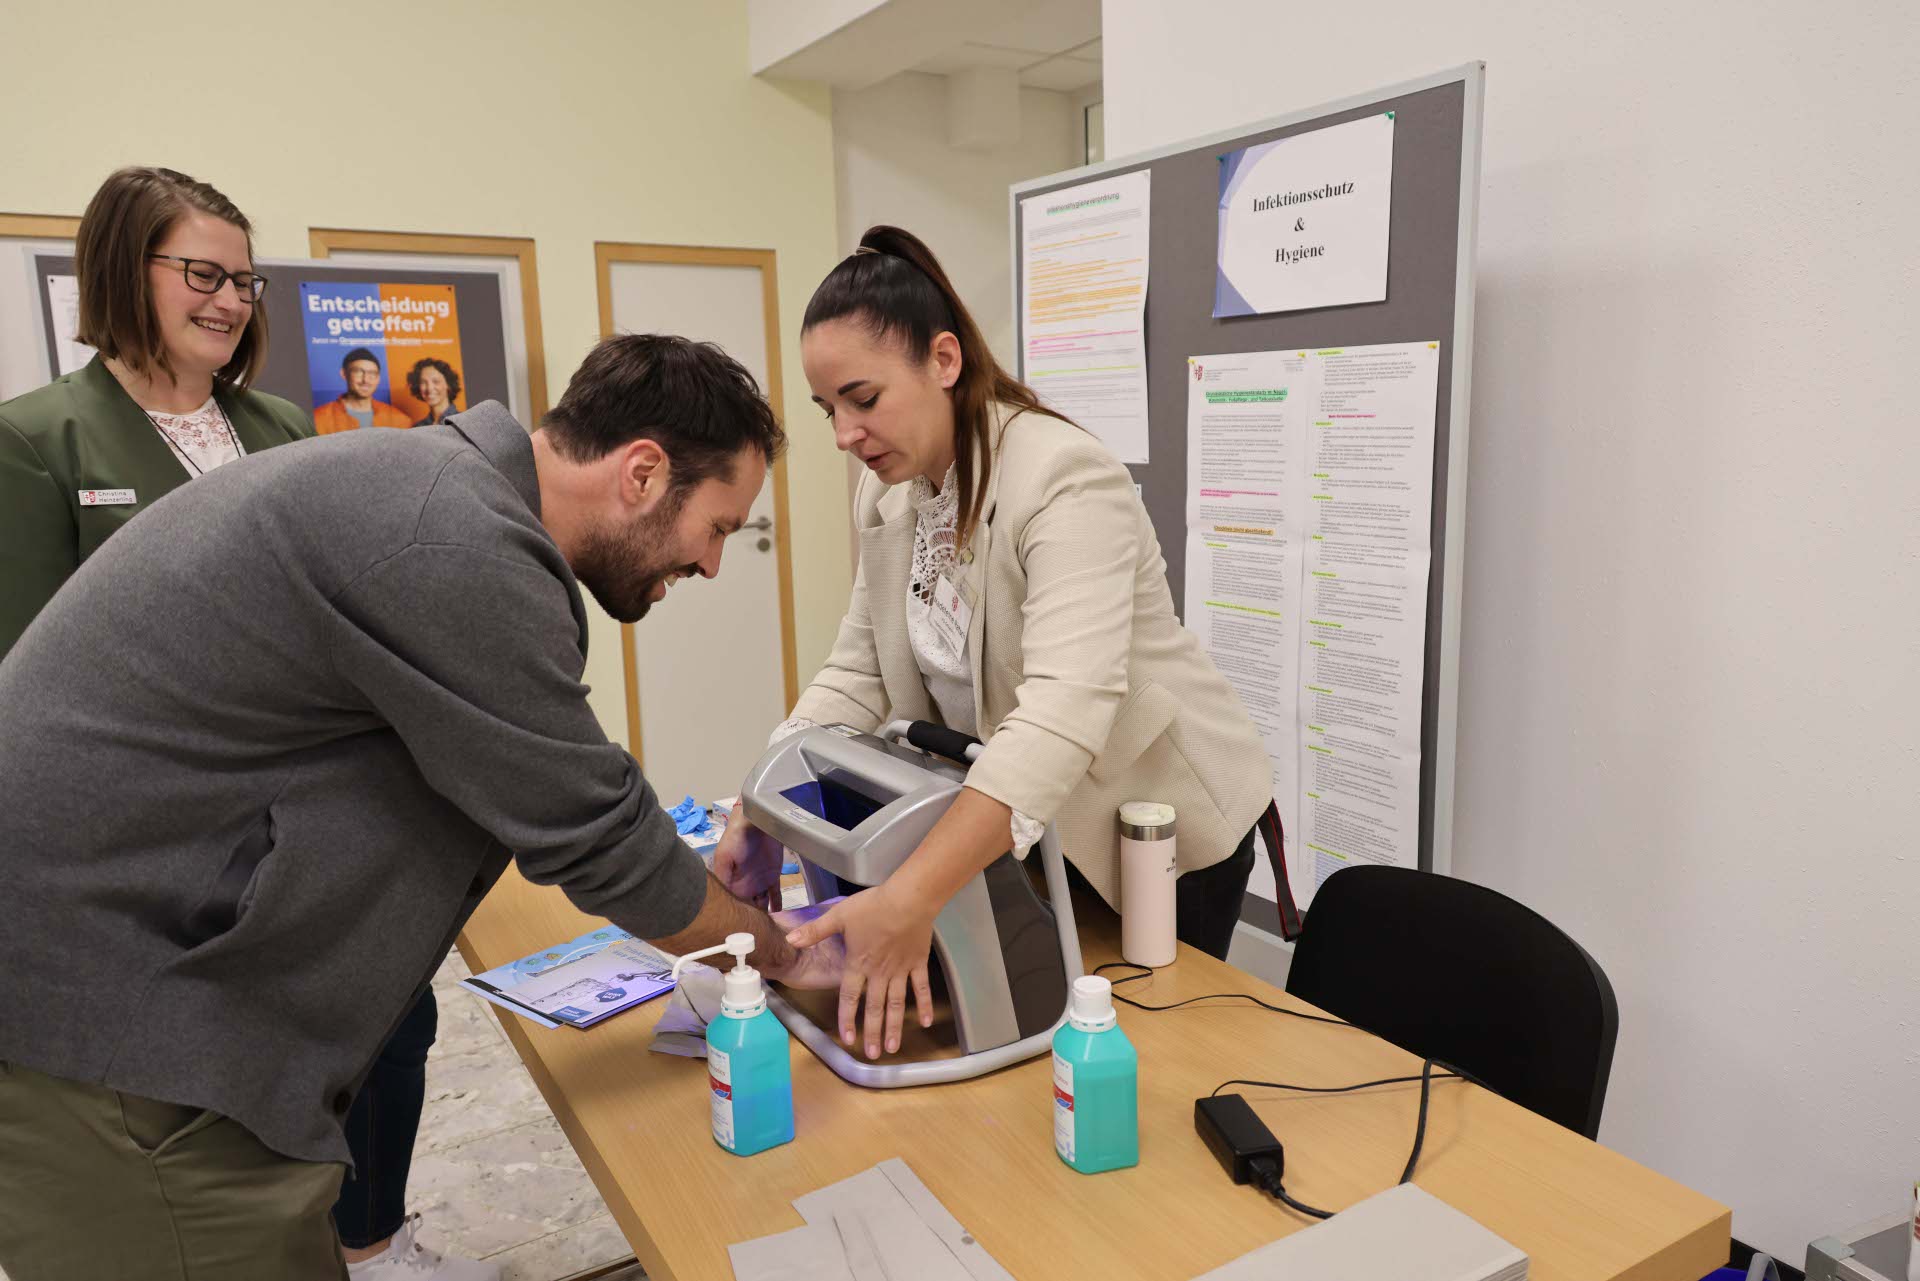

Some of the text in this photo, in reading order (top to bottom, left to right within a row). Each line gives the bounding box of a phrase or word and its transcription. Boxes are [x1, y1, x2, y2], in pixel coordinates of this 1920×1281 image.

[1253, 181, 1355, 212] Infektionsschutz
[1294, 217, 1305, 232] &
[1275, 244, 1325, 265] Hygiene
[307, 294, 450, 318] Entscheidung
[327, 315, 436, 336] getroffen?
